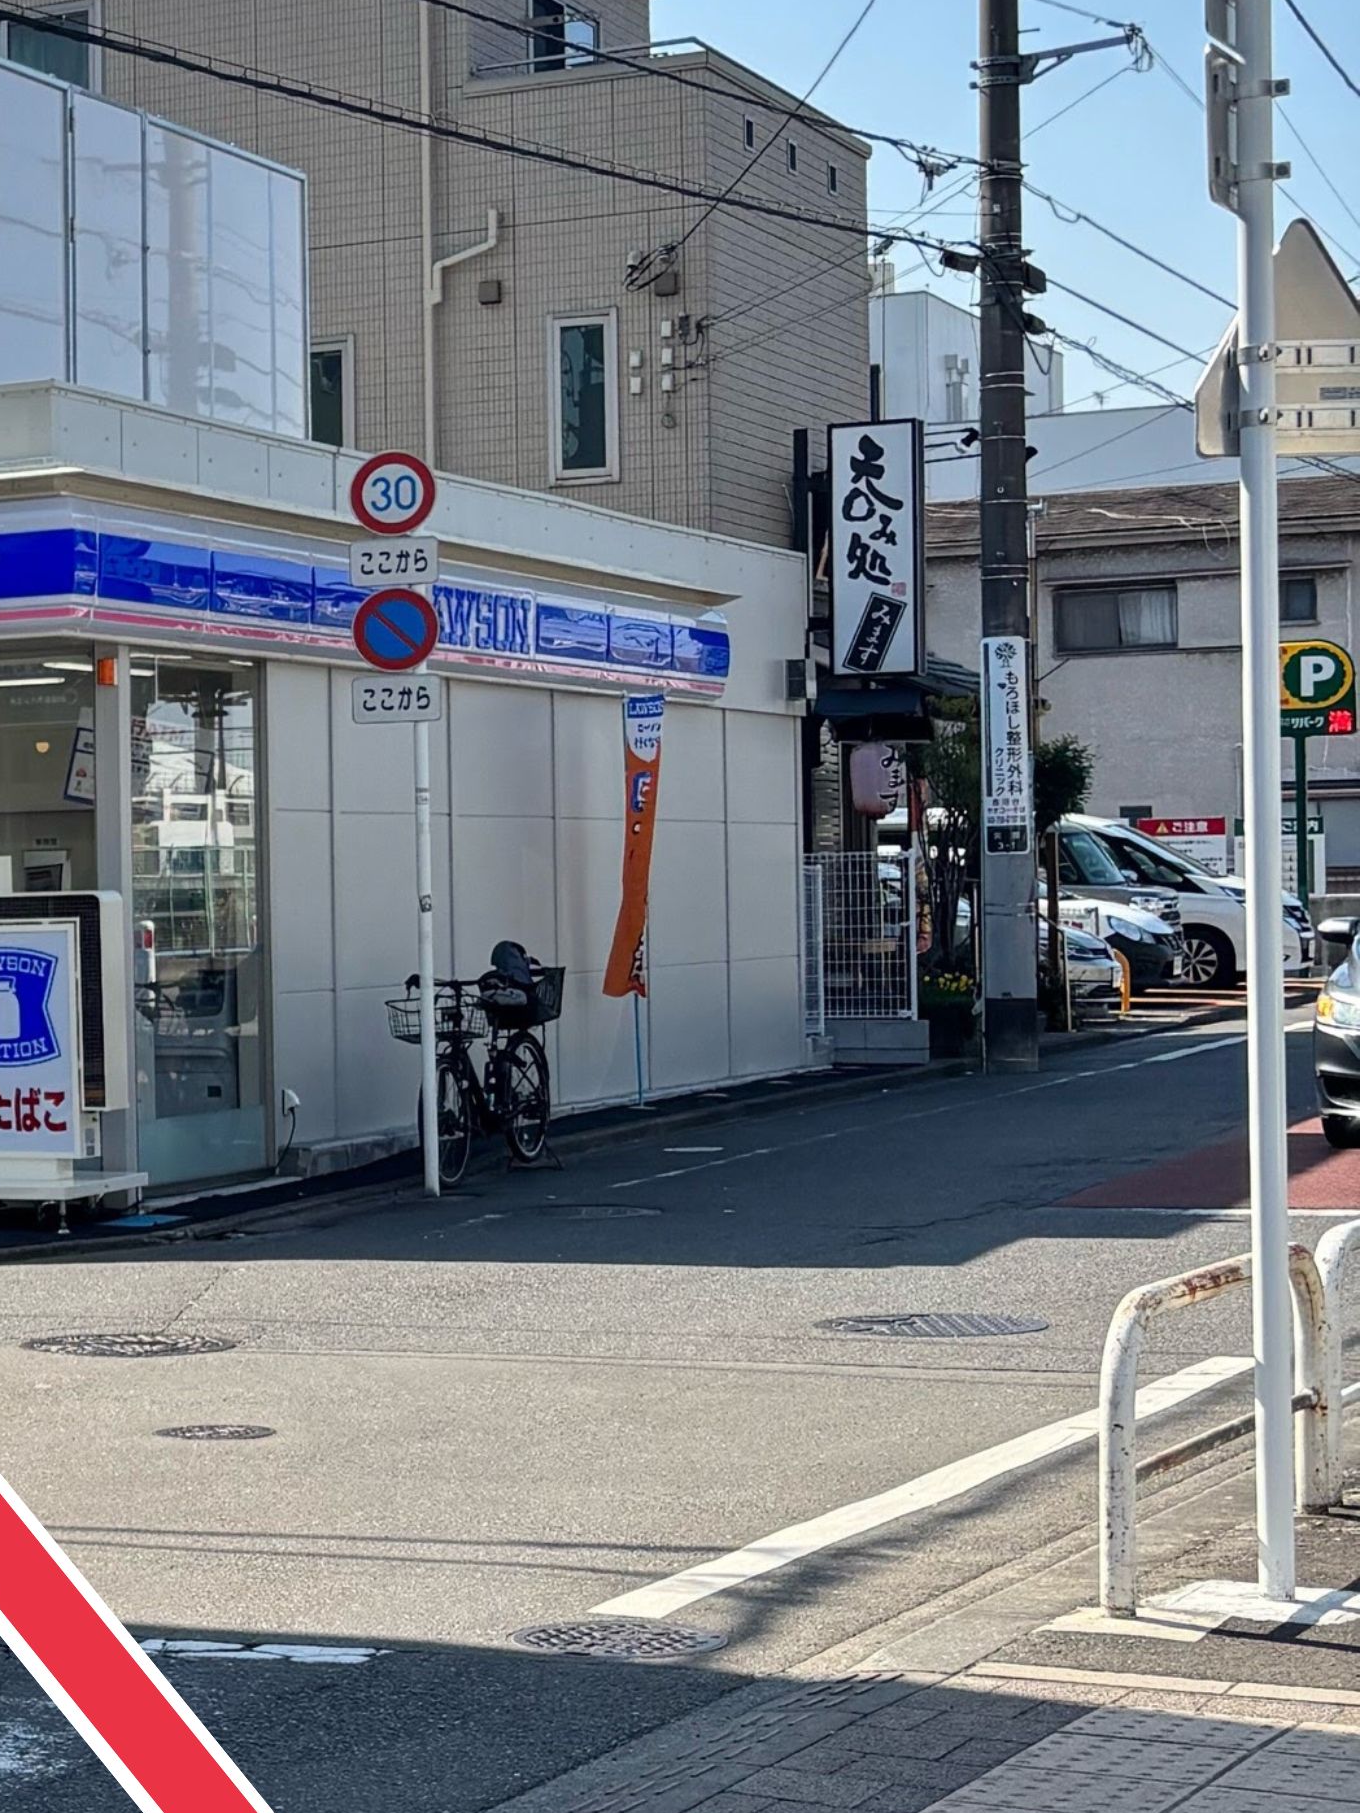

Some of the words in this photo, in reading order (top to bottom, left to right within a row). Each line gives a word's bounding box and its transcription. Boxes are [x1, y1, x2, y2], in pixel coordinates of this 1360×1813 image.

[371, 475, 417, 512] 30
[360, 549, 428, 575] ここから
[1300, 655, 1336, 697] P
[362, 686, 431, 711] ここから
[1005, 671, 1023, 796] もろほし整形外科
[994, 747, 1006, 796] クリニック
